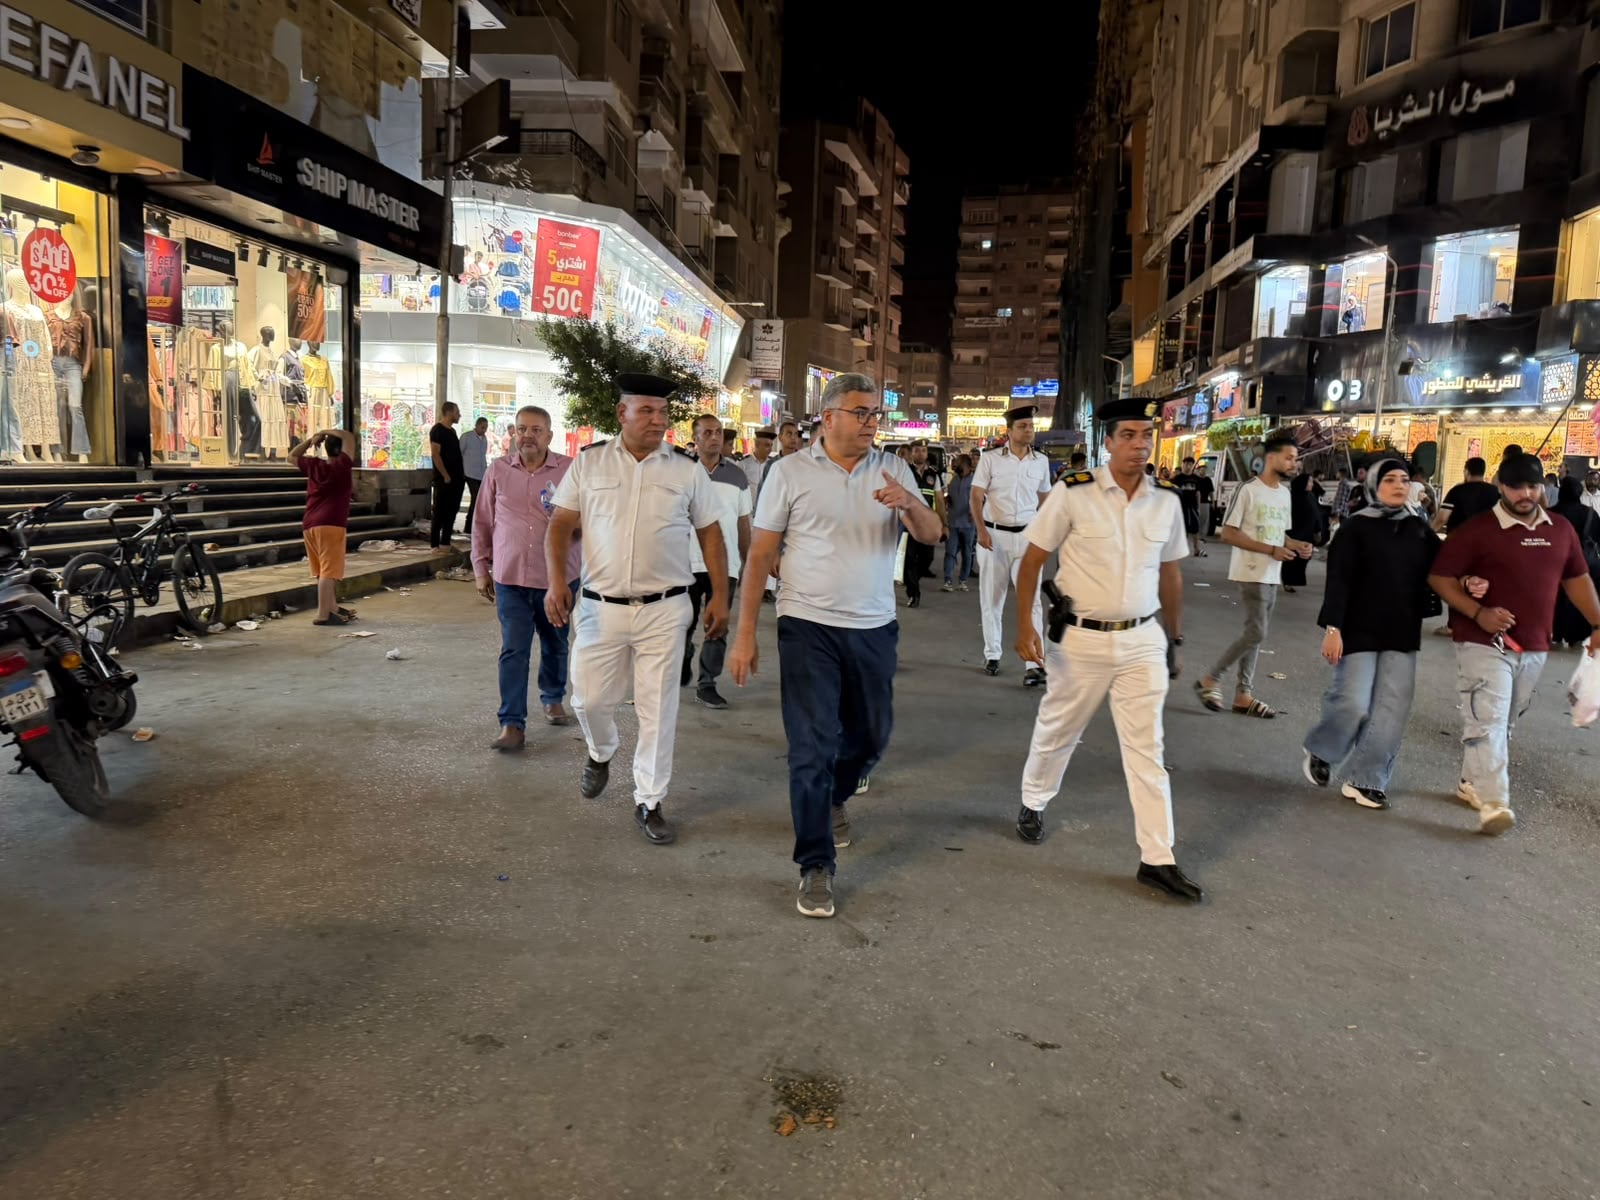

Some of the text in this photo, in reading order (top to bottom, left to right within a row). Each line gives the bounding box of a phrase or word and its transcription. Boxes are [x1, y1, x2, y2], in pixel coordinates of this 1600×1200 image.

[0, 3, 191, 142] EFANEL
[1374, 80, 1515, 139] مول الثريا
[297, 157, 420, 232] SHIP MASTER
[32, 245, 67, 268] SALE
[158, 255, 175, 266] GET
[547, 248, 586, 271] اشتري 5
[53, 288, 69, 298] OFF
[542, 285, 583, 313] 500
[1421, 373, 1521, 394] القريشي للعطور
